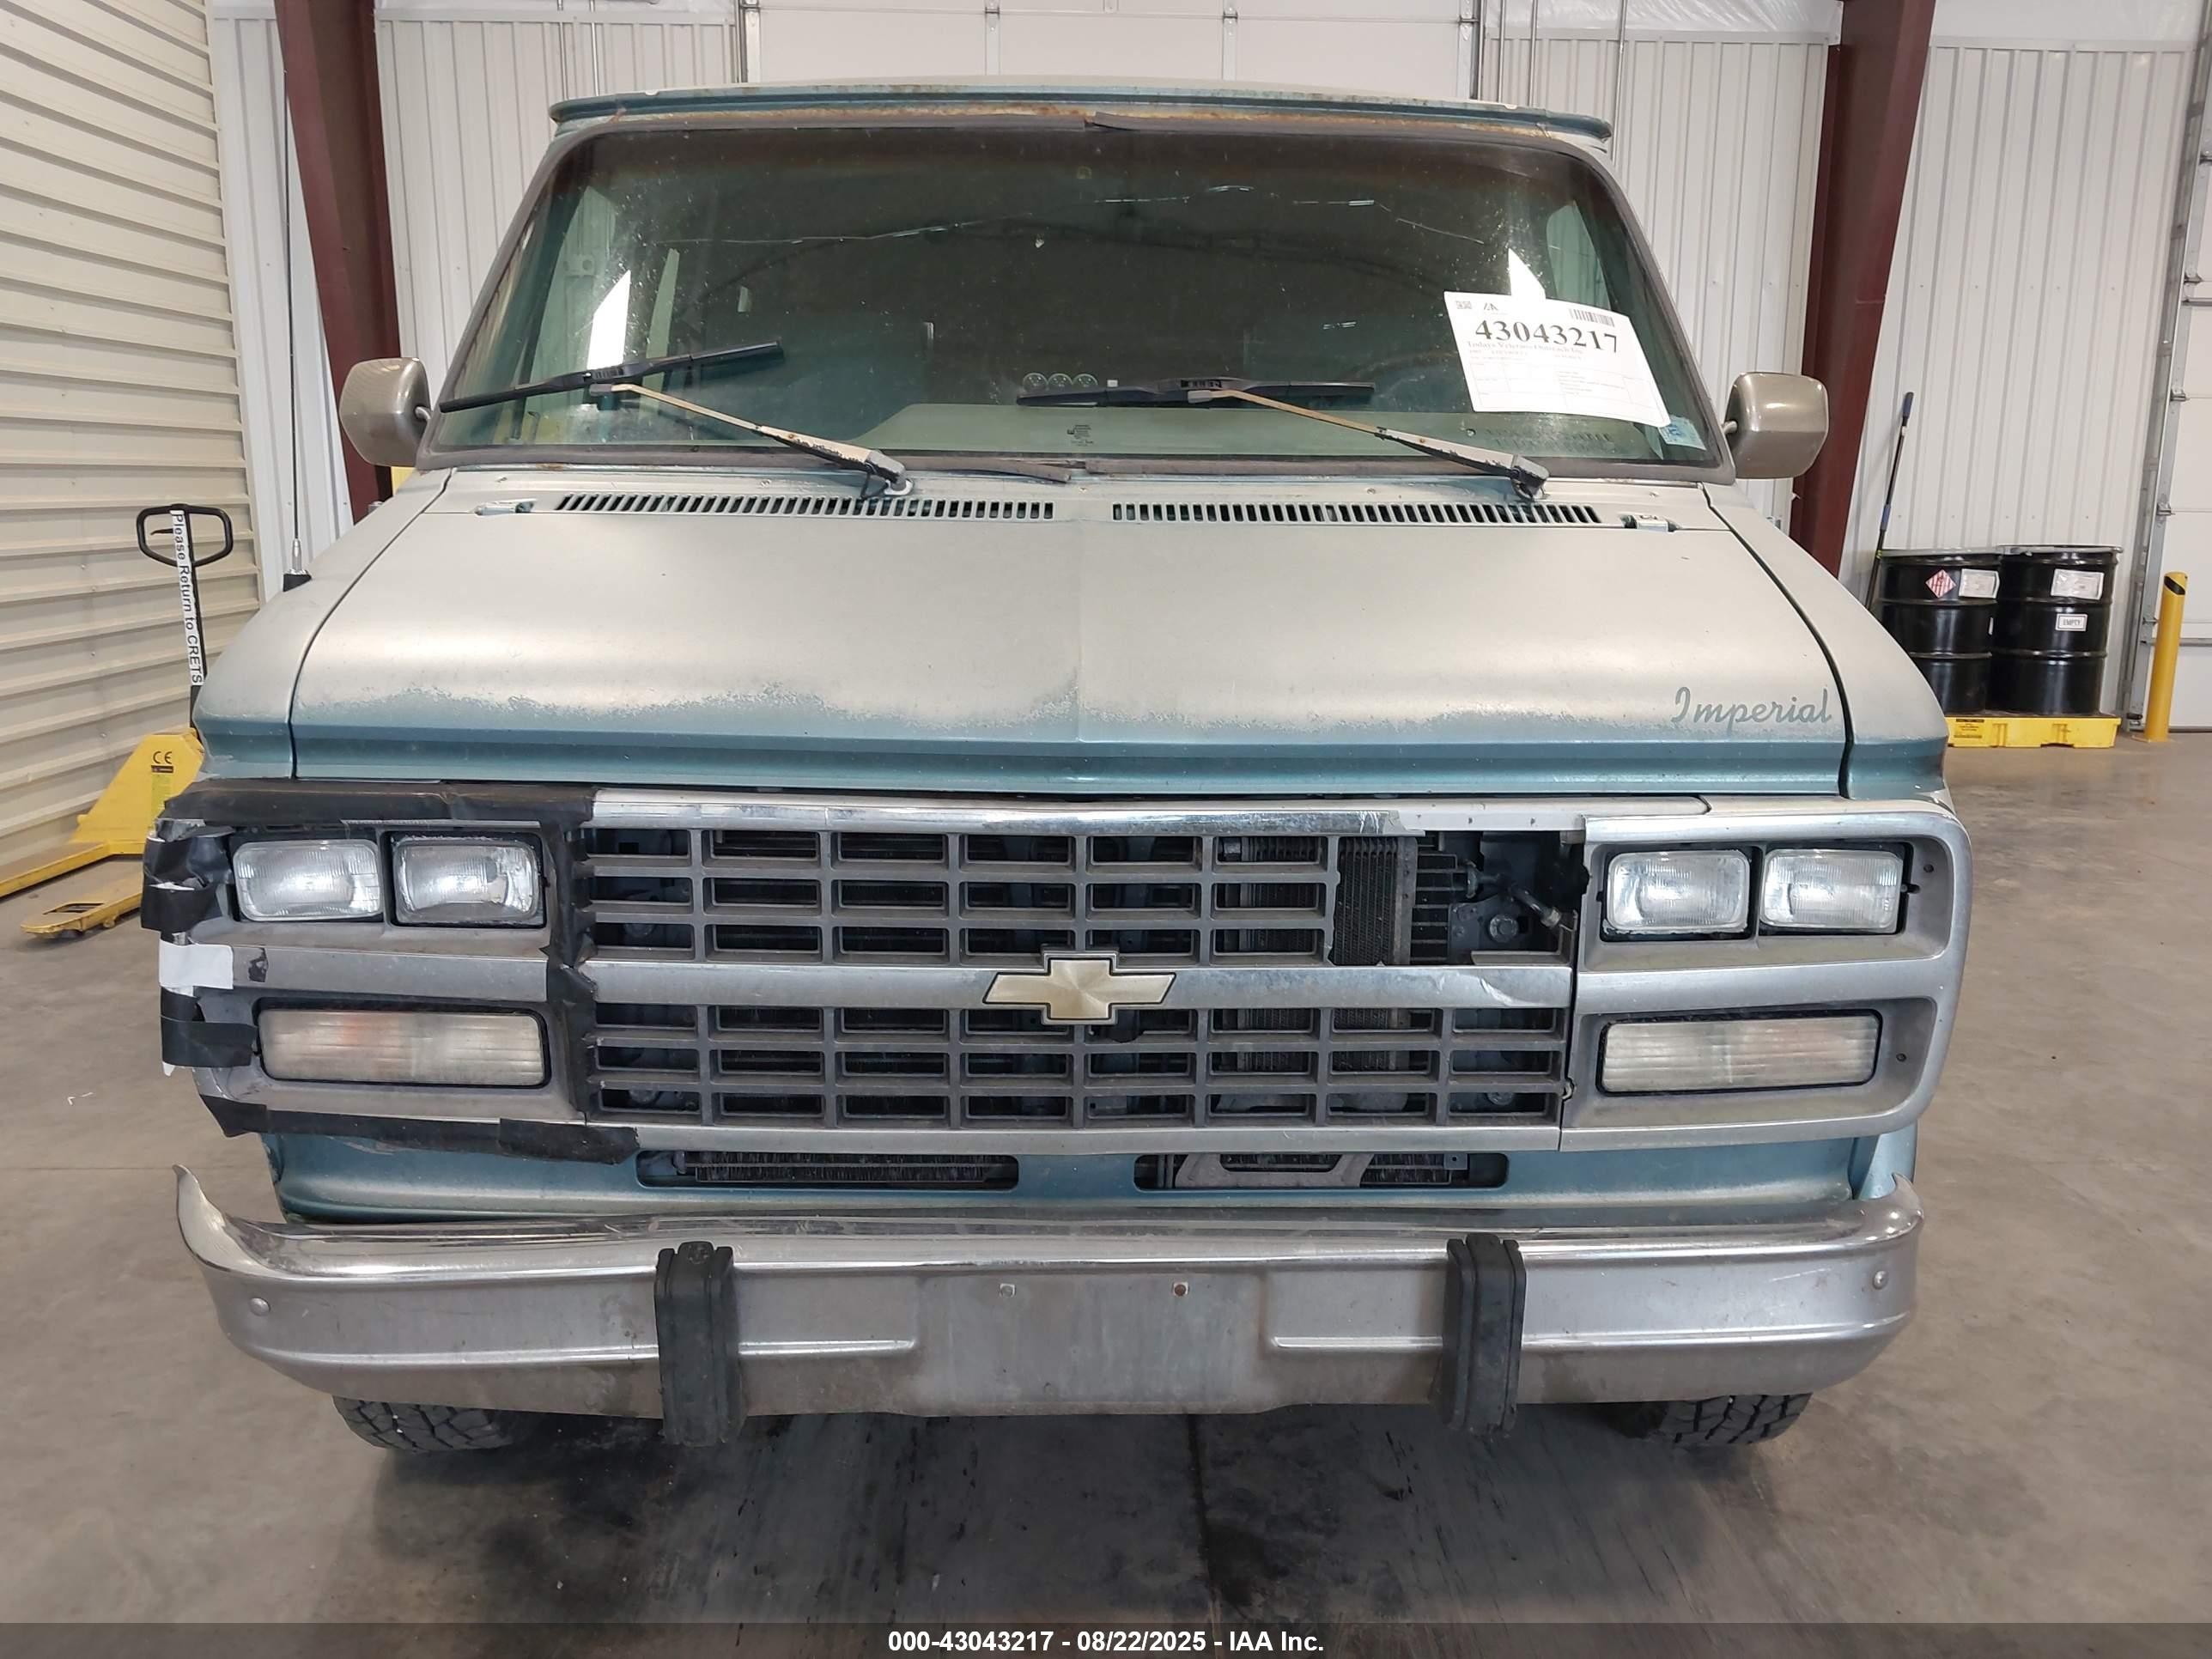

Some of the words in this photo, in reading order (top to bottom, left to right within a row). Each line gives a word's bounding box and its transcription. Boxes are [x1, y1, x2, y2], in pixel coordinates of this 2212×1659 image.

[1475, 319, 1618, 353] 43043217
[173, 514, 185, 561] Please
[179, 566, 191, 613] Return
[186, 617, 194, 631] to
[187, 635, 203, 684] CRETS
[1670, 686, 1832, 737] Imperial
[153, 750, 173, 764] CE
